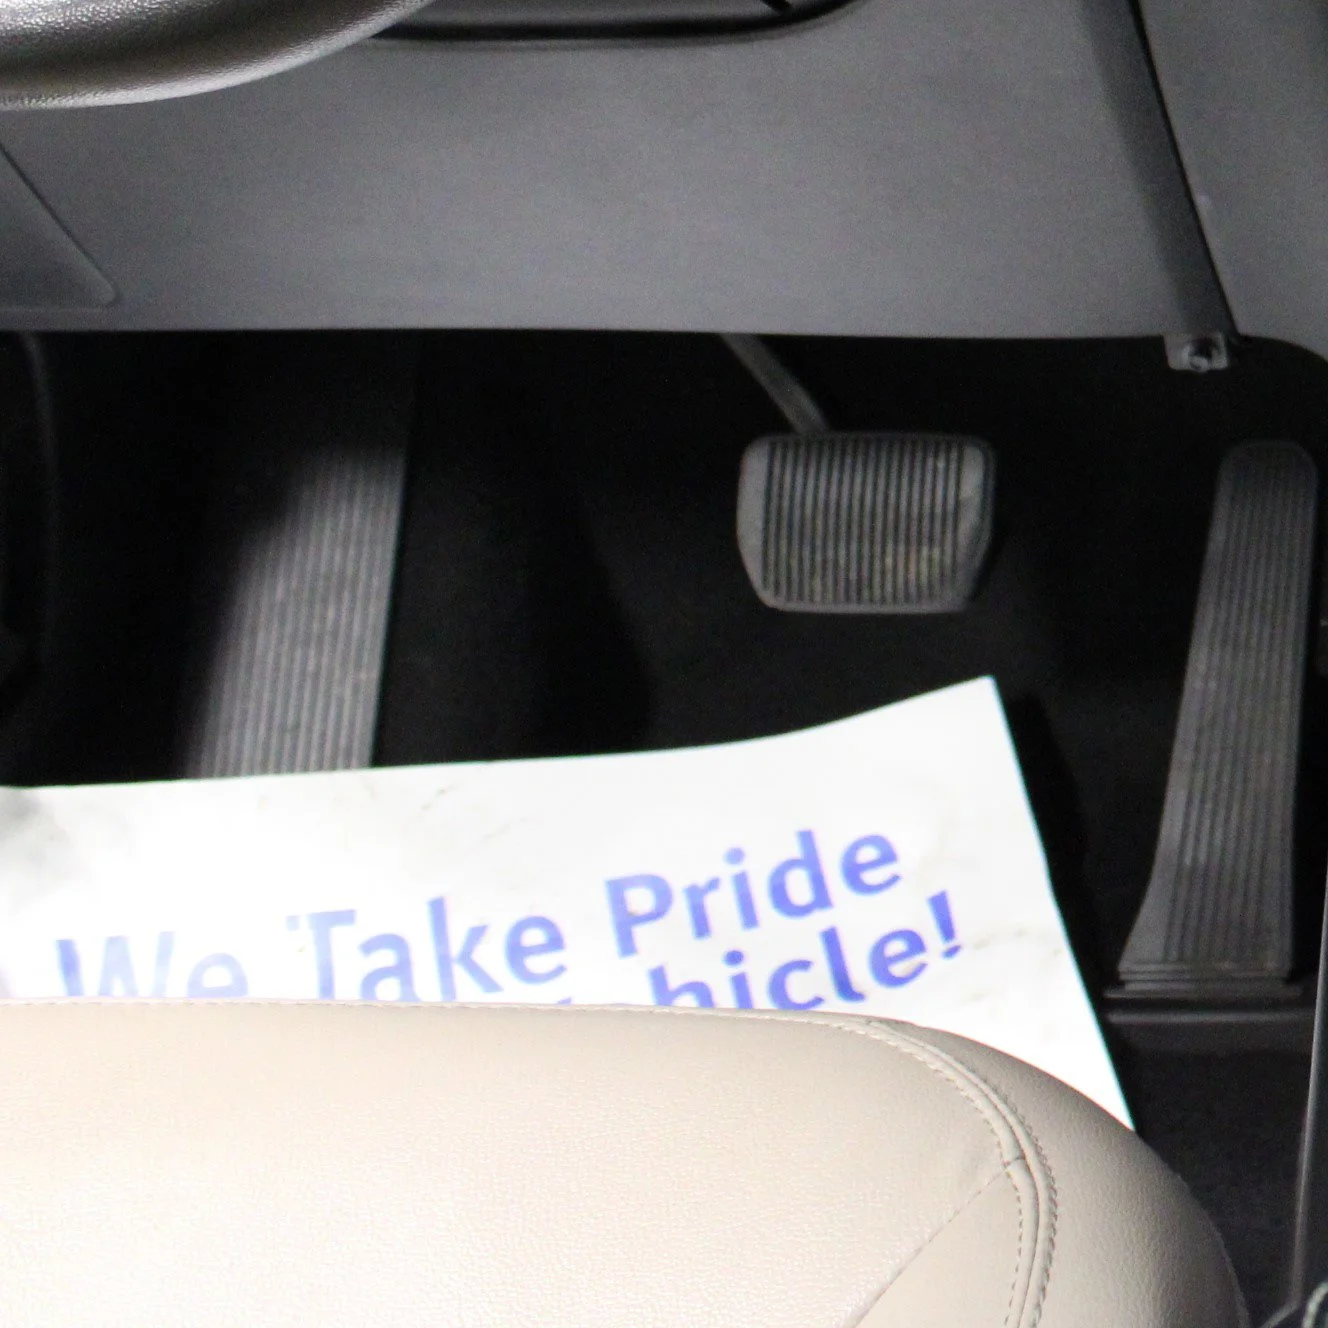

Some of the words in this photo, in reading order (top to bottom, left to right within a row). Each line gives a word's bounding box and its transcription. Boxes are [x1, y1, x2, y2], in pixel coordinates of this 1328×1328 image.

[285, 896, 568, 1002] Take
[604, 829, 901, 959] Pride
[648, 891, 964, 1012] hicle!
